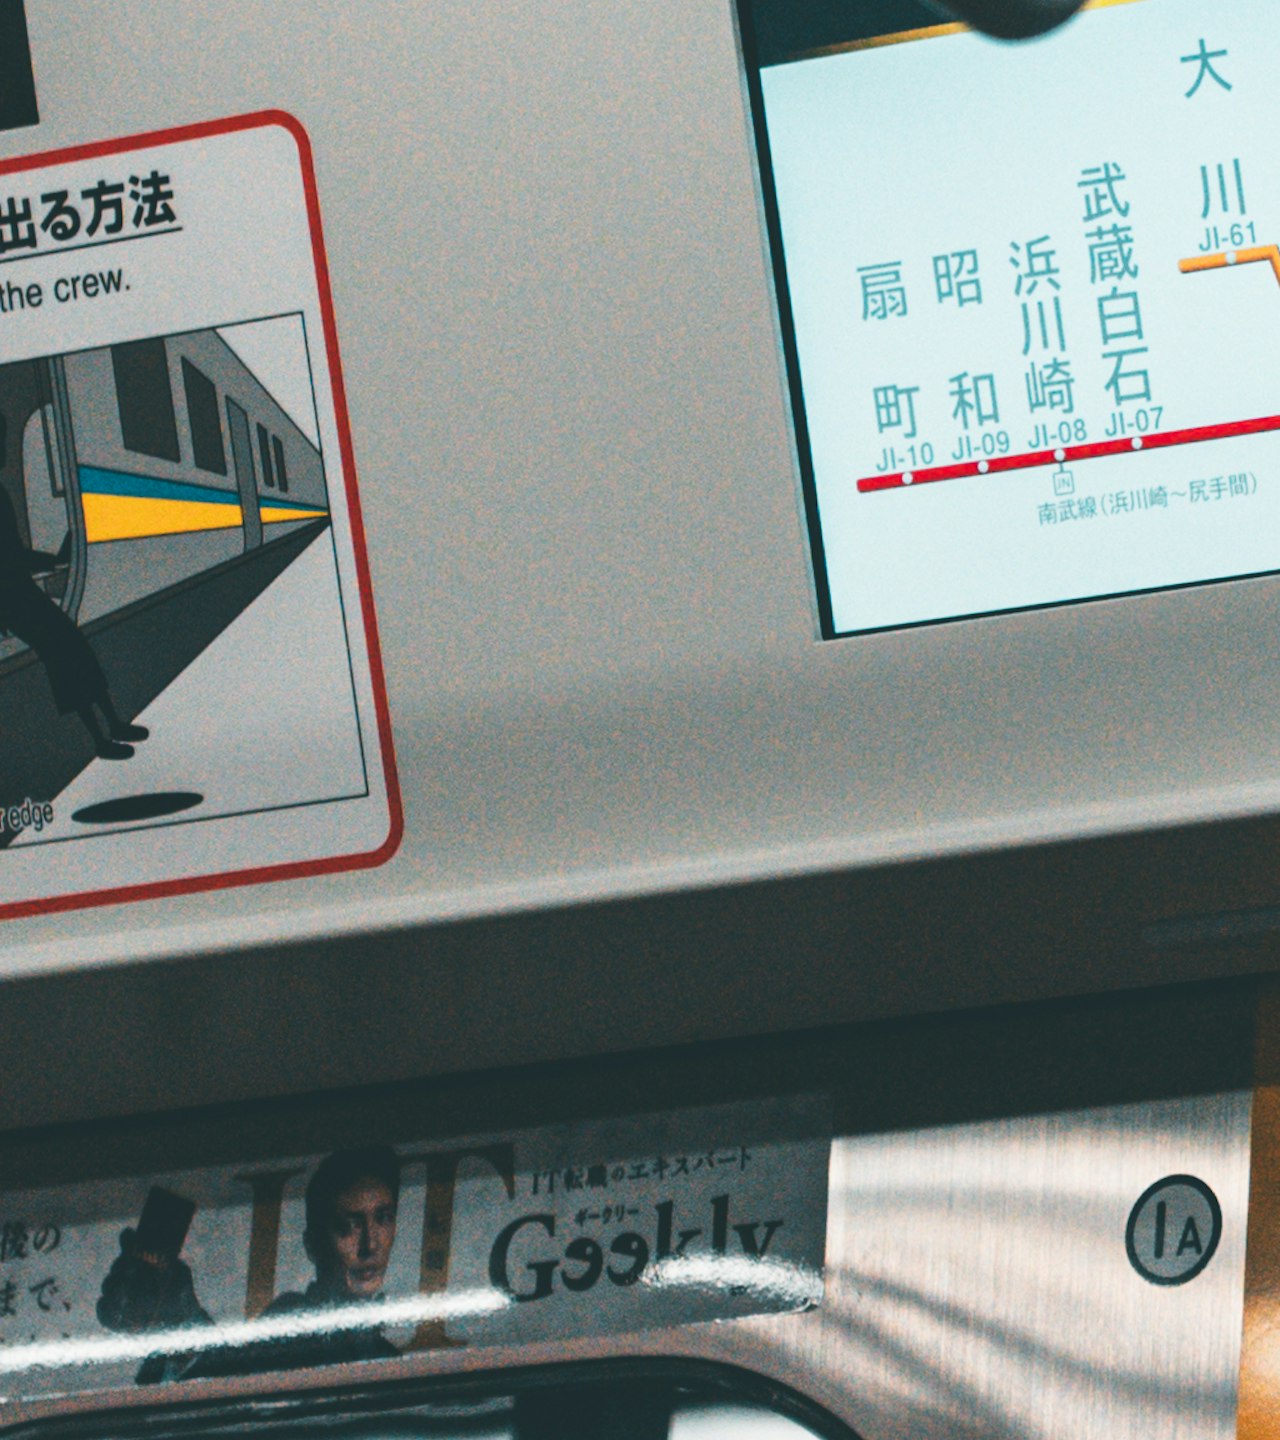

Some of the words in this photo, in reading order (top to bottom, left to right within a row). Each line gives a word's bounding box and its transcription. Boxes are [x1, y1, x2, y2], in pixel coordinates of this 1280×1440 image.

[1198, 221, 1258, 252] JI-61
[0, 280, 43, 313] the
[54, 268, 131, 303] crew.
[1077, 162, 1153, 406] 武蔵白石
[1009, 235, 1076, 415] 浜川崎
[1028, 419, 1088, 450] JI-08
[1105, 407, 1164, 439] JI-07
[876, 442, 934, 473] JI-10
[952, 431, 1011, 461] JI-09
[8, 797, 54, 832] edge
